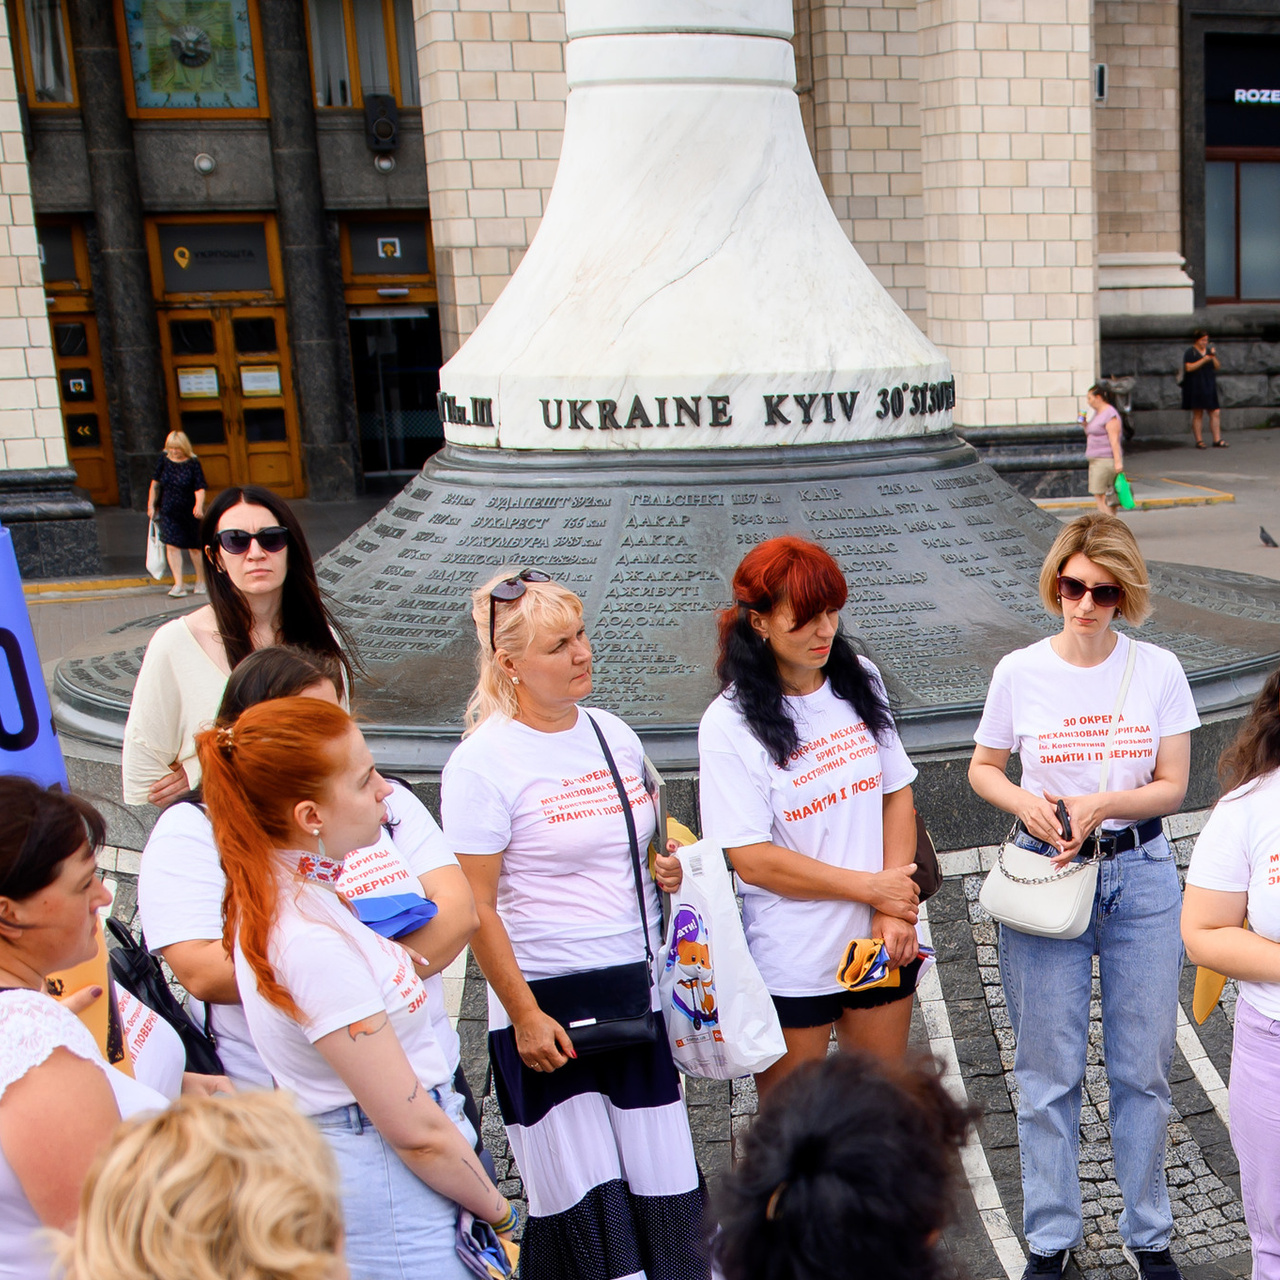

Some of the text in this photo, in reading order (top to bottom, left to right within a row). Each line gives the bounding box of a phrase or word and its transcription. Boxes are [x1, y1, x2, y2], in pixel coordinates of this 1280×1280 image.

[539, 390, 861, 430] UKRAINE KYIV
[798, 487, 842, 501] КАЇР
[485, 497, 571, 511] БУДАПЕШТ
[805, 505, 894, 521] КАМПАЛА
[471, 517, 550, 529] БУХАРЕСТ
[624, 515, 690, 529] ДАКАР
[811, 523, 901, 540] КАНБЕРРА
[620, 535, 688, 548] ДАККА
[616, 553, 698, 566] ДАМАСК
[841, 560, 892, 573] АСТРІ
[610, 571, 720, 583] ДЖАКАРТА
[848, 571, 928, 588] АТМАНДУ
[605, 586, 699, 599] ДЖИБУТІ
[394, 598, 468, 612] ВАРШАВА
[595, 616, 679, 628] ДОДОМА
[590, 630, 644, 641] ДОХА
[592, 654, 677, 664] УШАНБЕ
[1063, 718, 1076, 727] 30
[830, 721, 868, 742] МЕХАНІЗ
[815, 738, 858, 762] БРИГАДА
[1040, 748, 1153, 764] ЗНАЙТИ І ПВЕРНУТИ
[792, 757, 847, 788] КОСТЯНТИНА
[839, 787, 848, 800] І
[349, 849, 391, 871] БРИГАДА
[346, 859, 401, 884] Острозького
